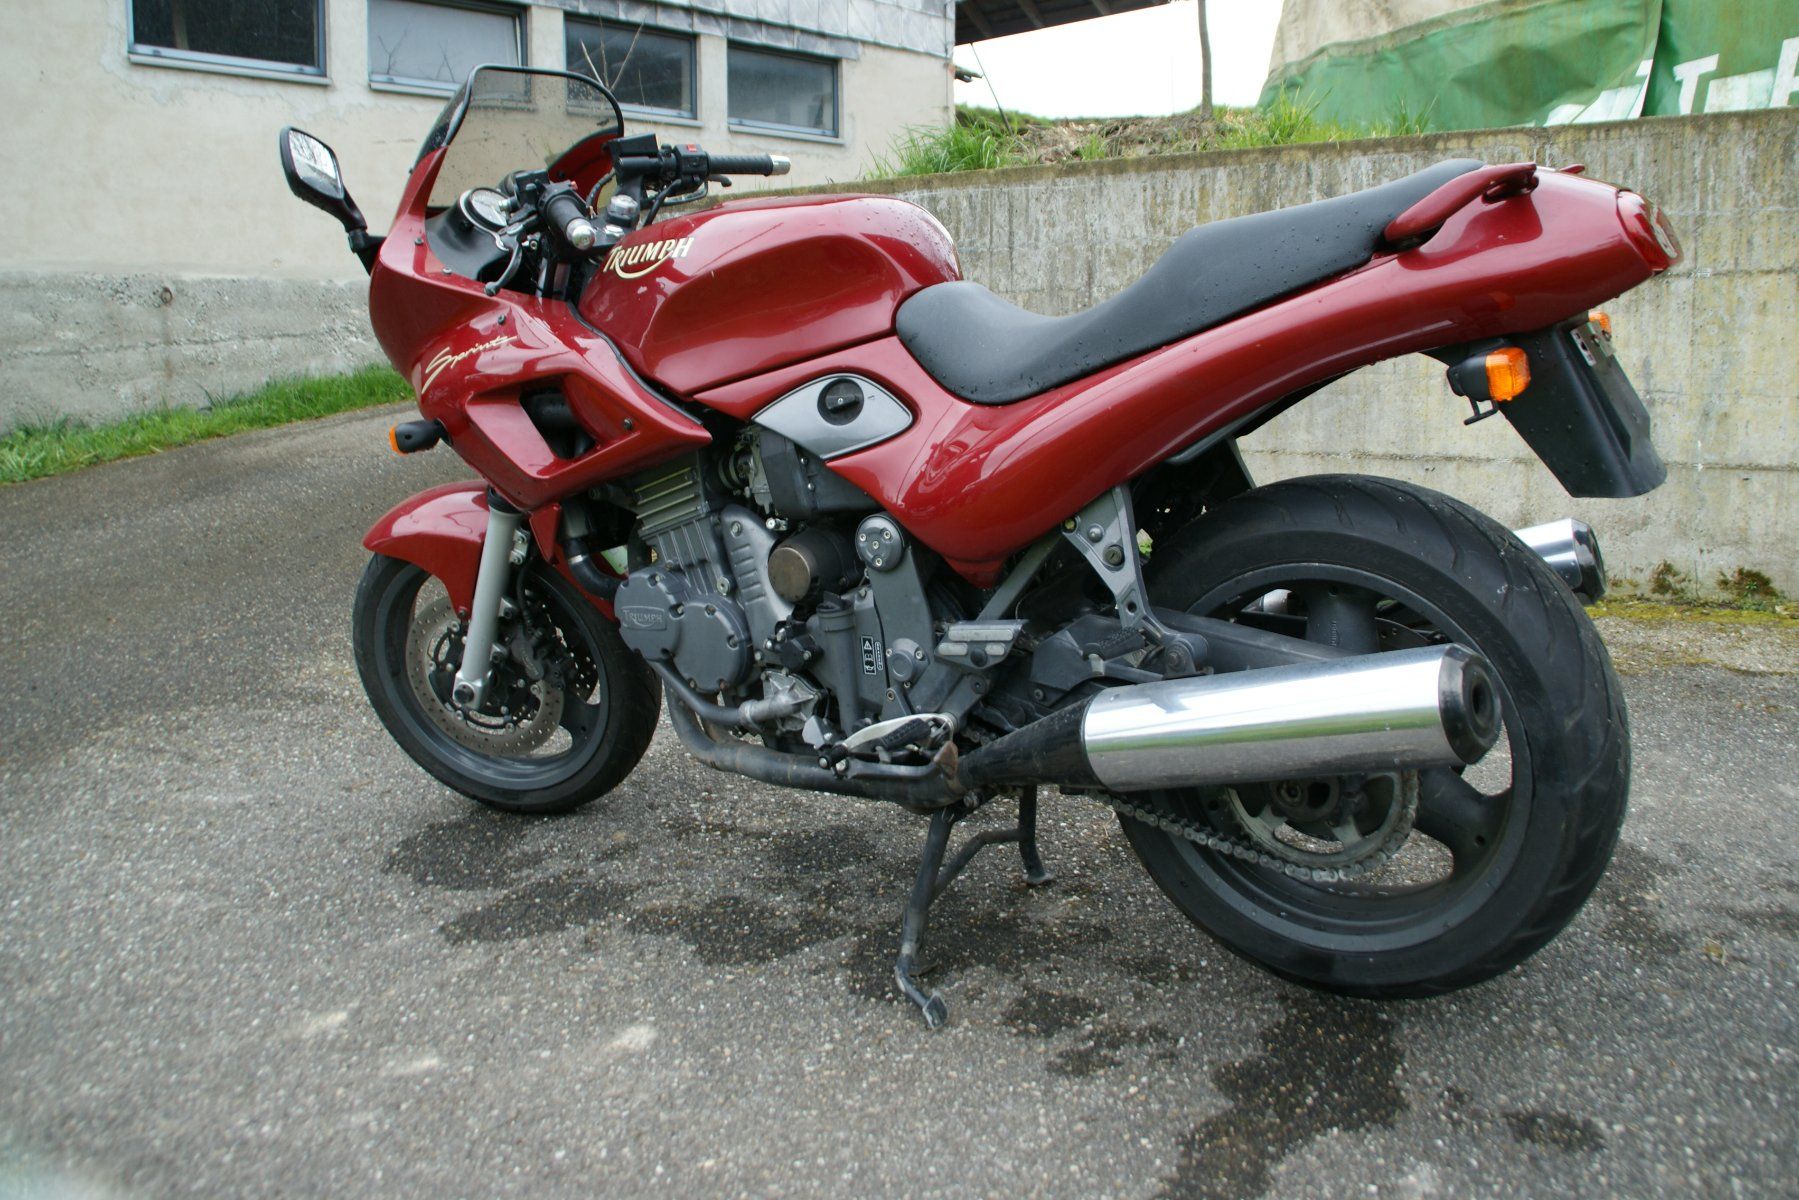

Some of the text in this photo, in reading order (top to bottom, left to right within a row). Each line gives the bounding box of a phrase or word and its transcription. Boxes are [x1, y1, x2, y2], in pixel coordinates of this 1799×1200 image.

[603, 237, 695, 279] TRIUMPH
[421, 335, 518, 395] Sprint
[622, 609, 663, 627] TRIUMPH
